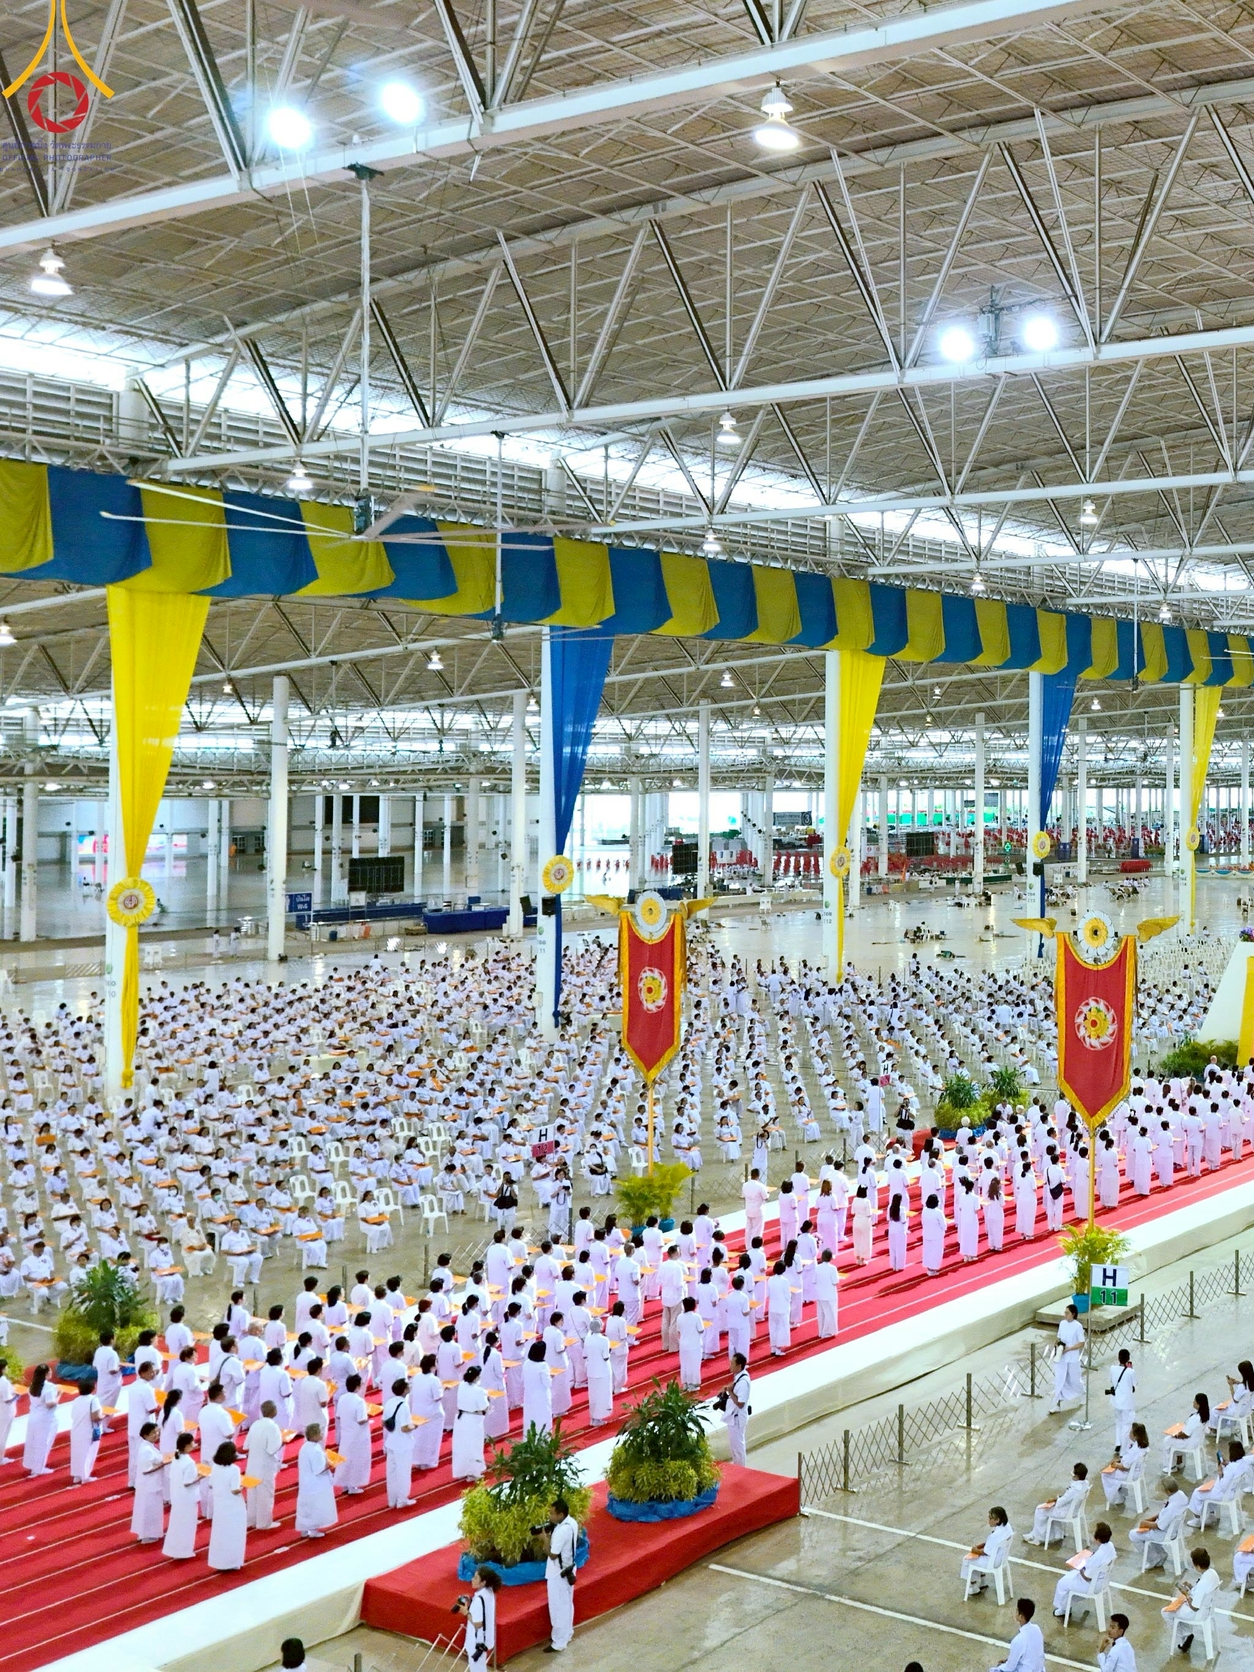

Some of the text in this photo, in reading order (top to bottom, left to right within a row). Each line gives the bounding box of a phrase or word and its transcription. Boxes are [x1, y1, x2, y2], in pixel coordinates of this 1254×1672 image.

[883, 1063, 889, 1075] H
[538, 1128, 548, 1143] H
[537, 1143, 548, 1155] 12
[1102, 1268, 1117, 1287] H
[1100, 1289, 1118, 1305] 11
